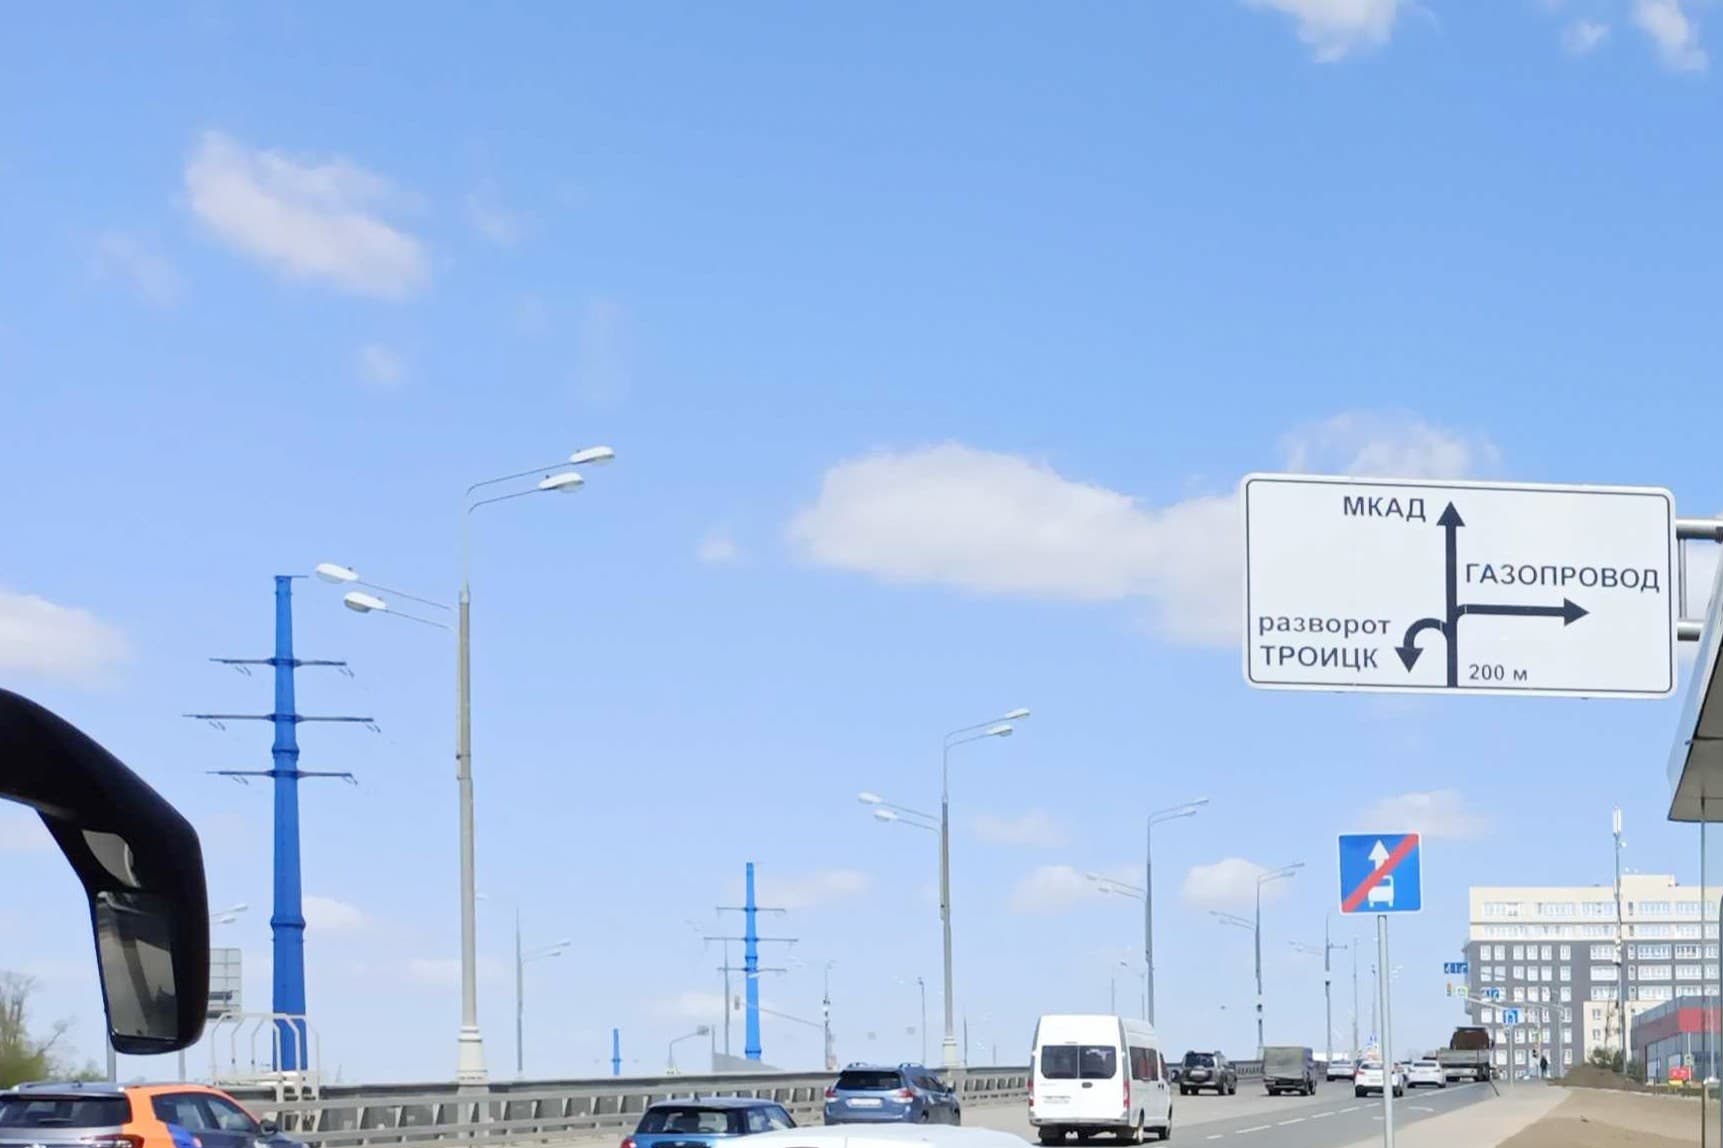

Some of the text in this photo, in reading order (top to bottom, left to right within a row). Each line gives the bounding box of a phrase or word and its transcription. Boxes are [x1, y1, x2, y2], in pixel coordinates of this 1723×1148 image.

[1343, 495, 1426, 523] МКАД
[1466, 563, 1660, 593] ГАЗОПРОВОД
[1258, 615, 1391, 639] разворот
[1260, 645, 1379, 672] ТРОИЦК
[1469, 664, 1528, 681] 200 м
